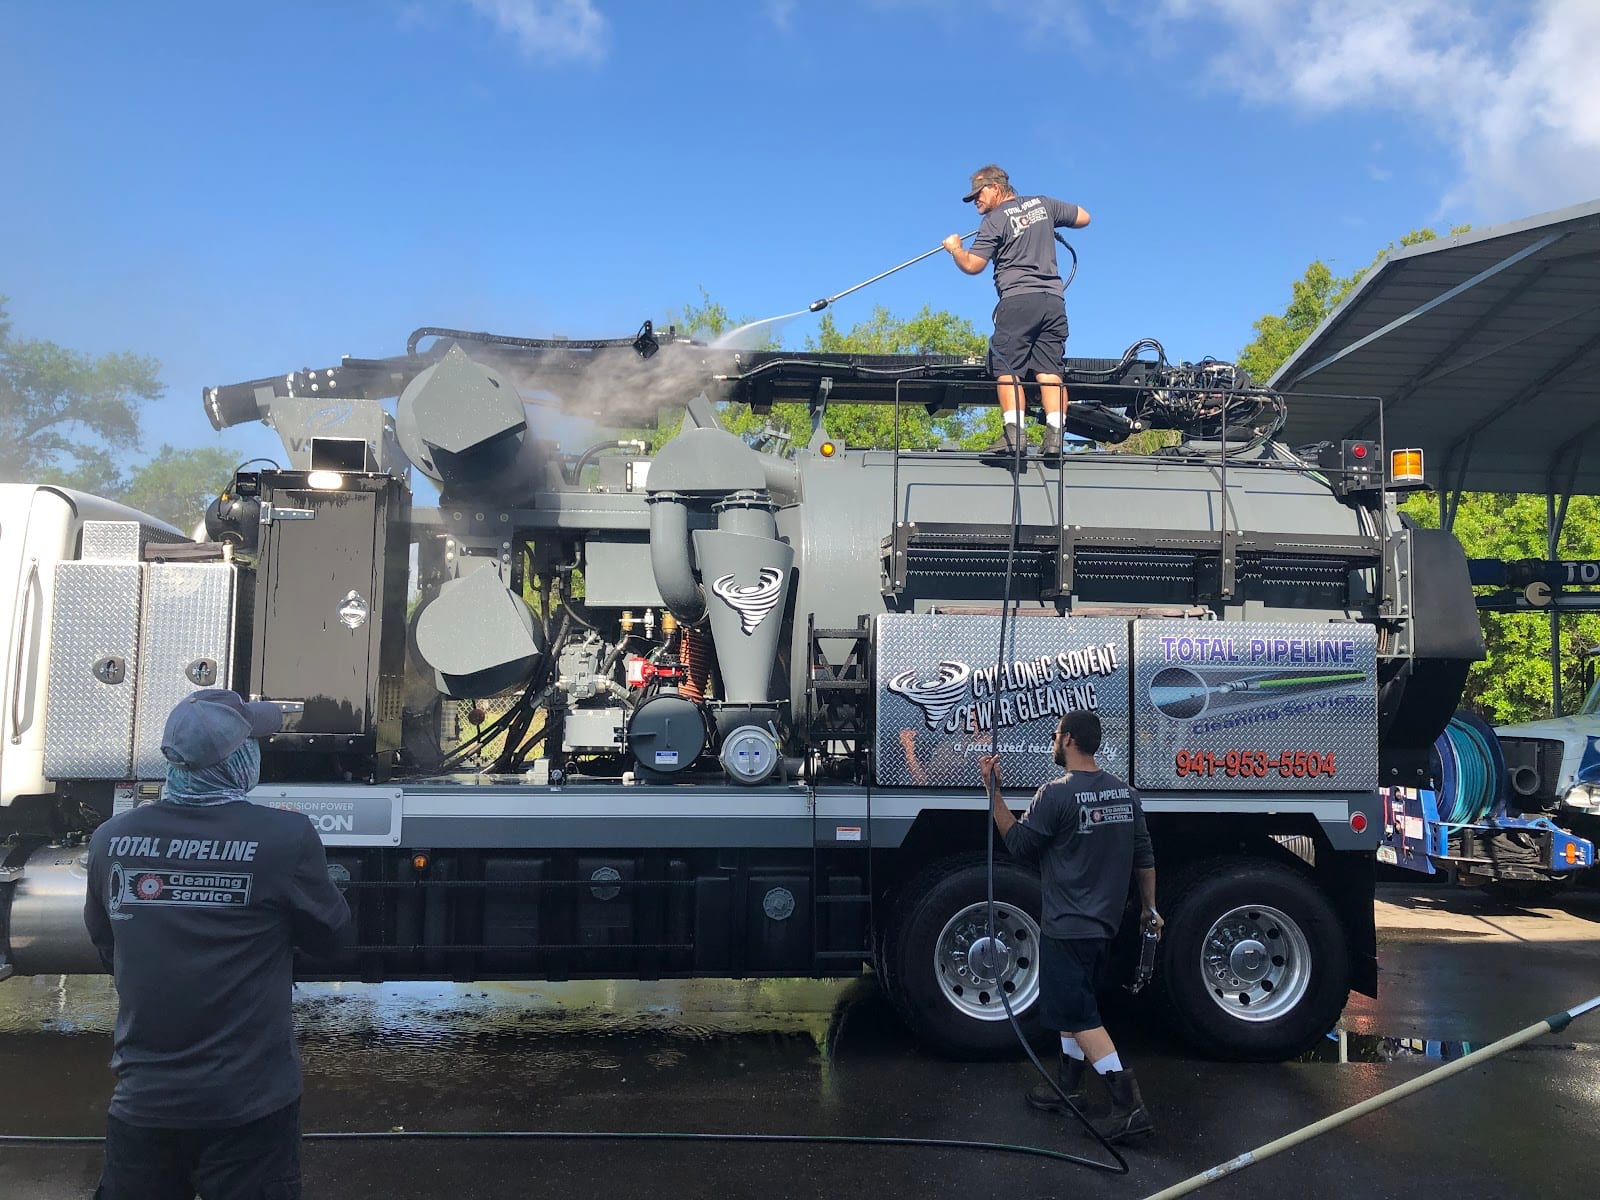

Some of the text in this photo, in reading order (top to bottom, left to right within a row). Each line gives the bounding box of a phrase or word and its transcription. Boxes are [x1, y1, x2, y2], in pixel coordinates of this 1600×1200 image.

[1057, 642, 1117, 681] SOVENT
[1160, 637, 1355, 665] TOTAL PIPELINE
[1017, 682, 1098, 721] CLEANING
[1176, 750, 1336, 778] 941-953-5504
[320, 802, 354, 811] POWER
[1075, 791, 1097, 803] TOTAL
[106, 836, 259, 862] TOTAL PIPELINE
[169, 874, 242, 889] Cleaning
[171, 889, 233, 902] Service
